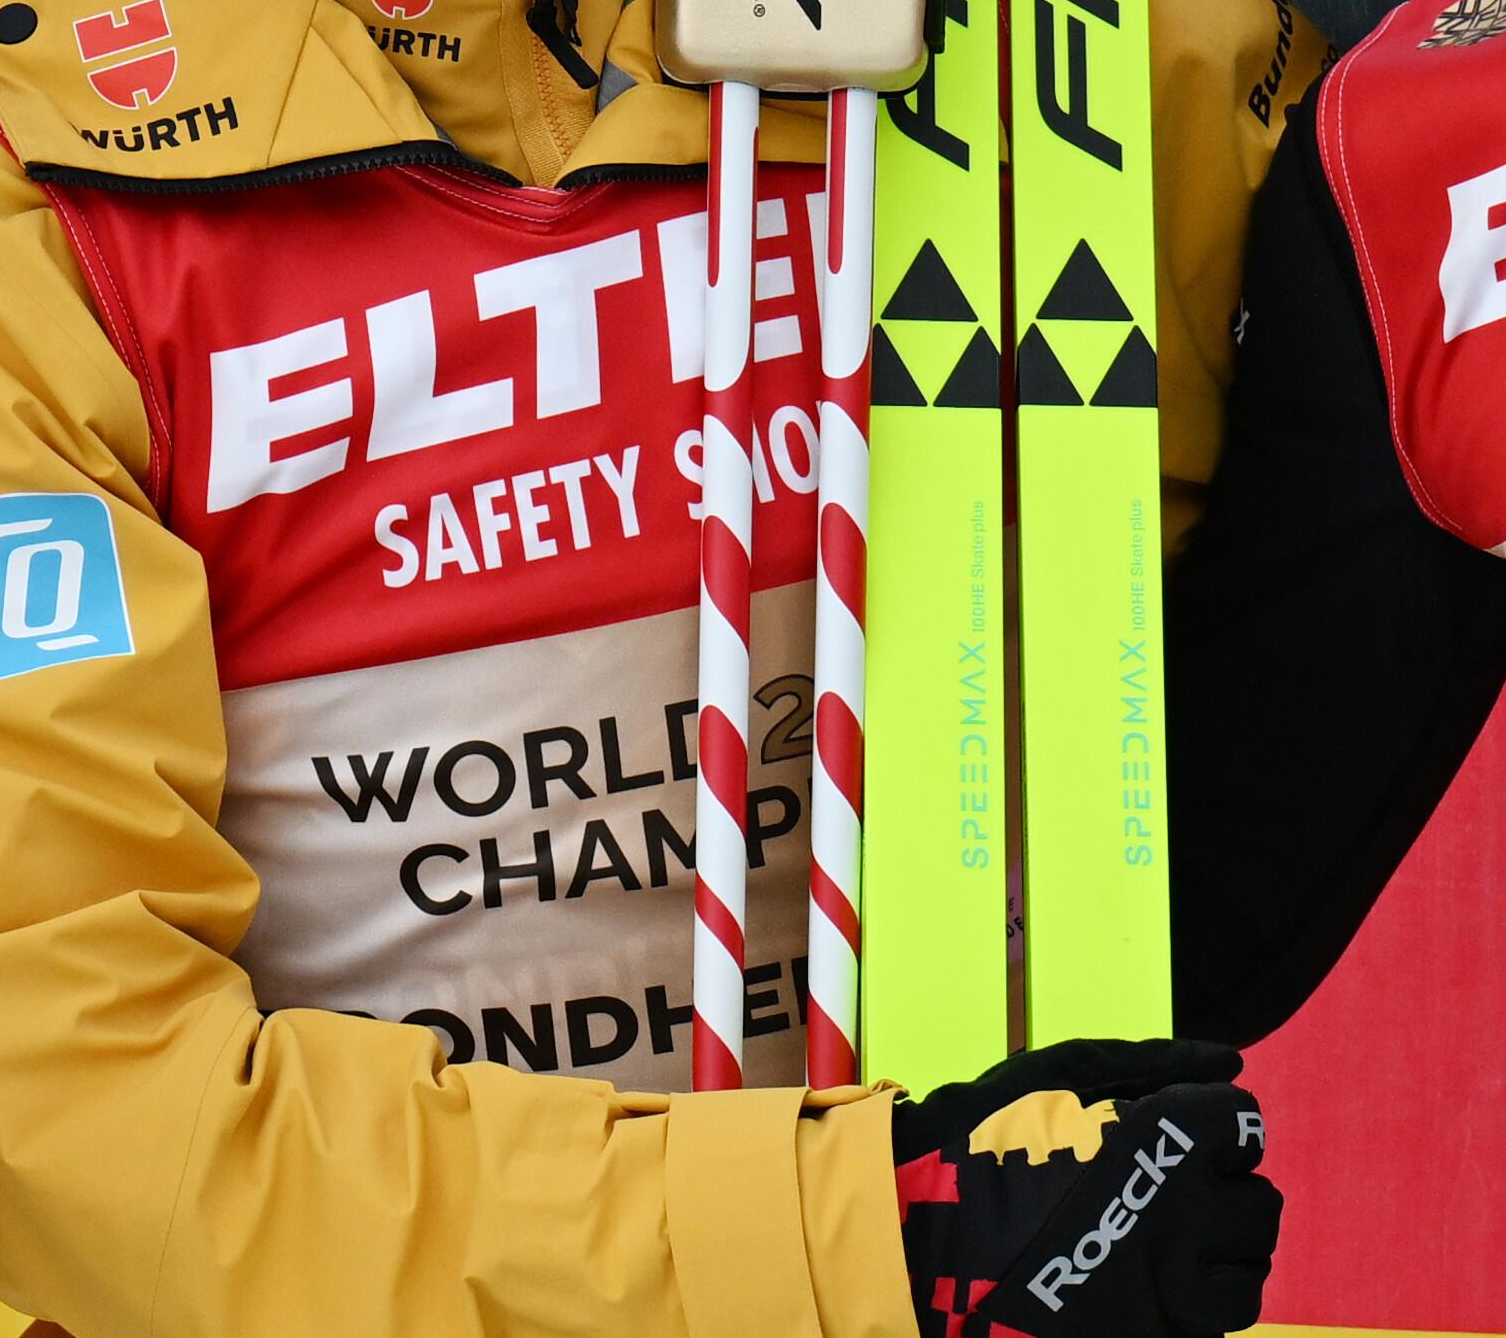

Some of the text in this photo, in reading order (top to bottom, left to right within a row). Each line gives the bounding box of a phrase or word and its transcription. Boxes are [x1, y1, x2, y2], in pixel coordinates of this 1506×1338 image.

[374, 445, 648, 590] SAFETY
[972, 500, 987, 537] plus
[1132, 498, 1147, 534] plus
[970, 537, 986, 578] Skate
[1130, 536, 1146, 577] Skate
[957, 640, 990, 870] SPEEDMAX
[1118, 638, 1153, 867] SPEEDMAX
